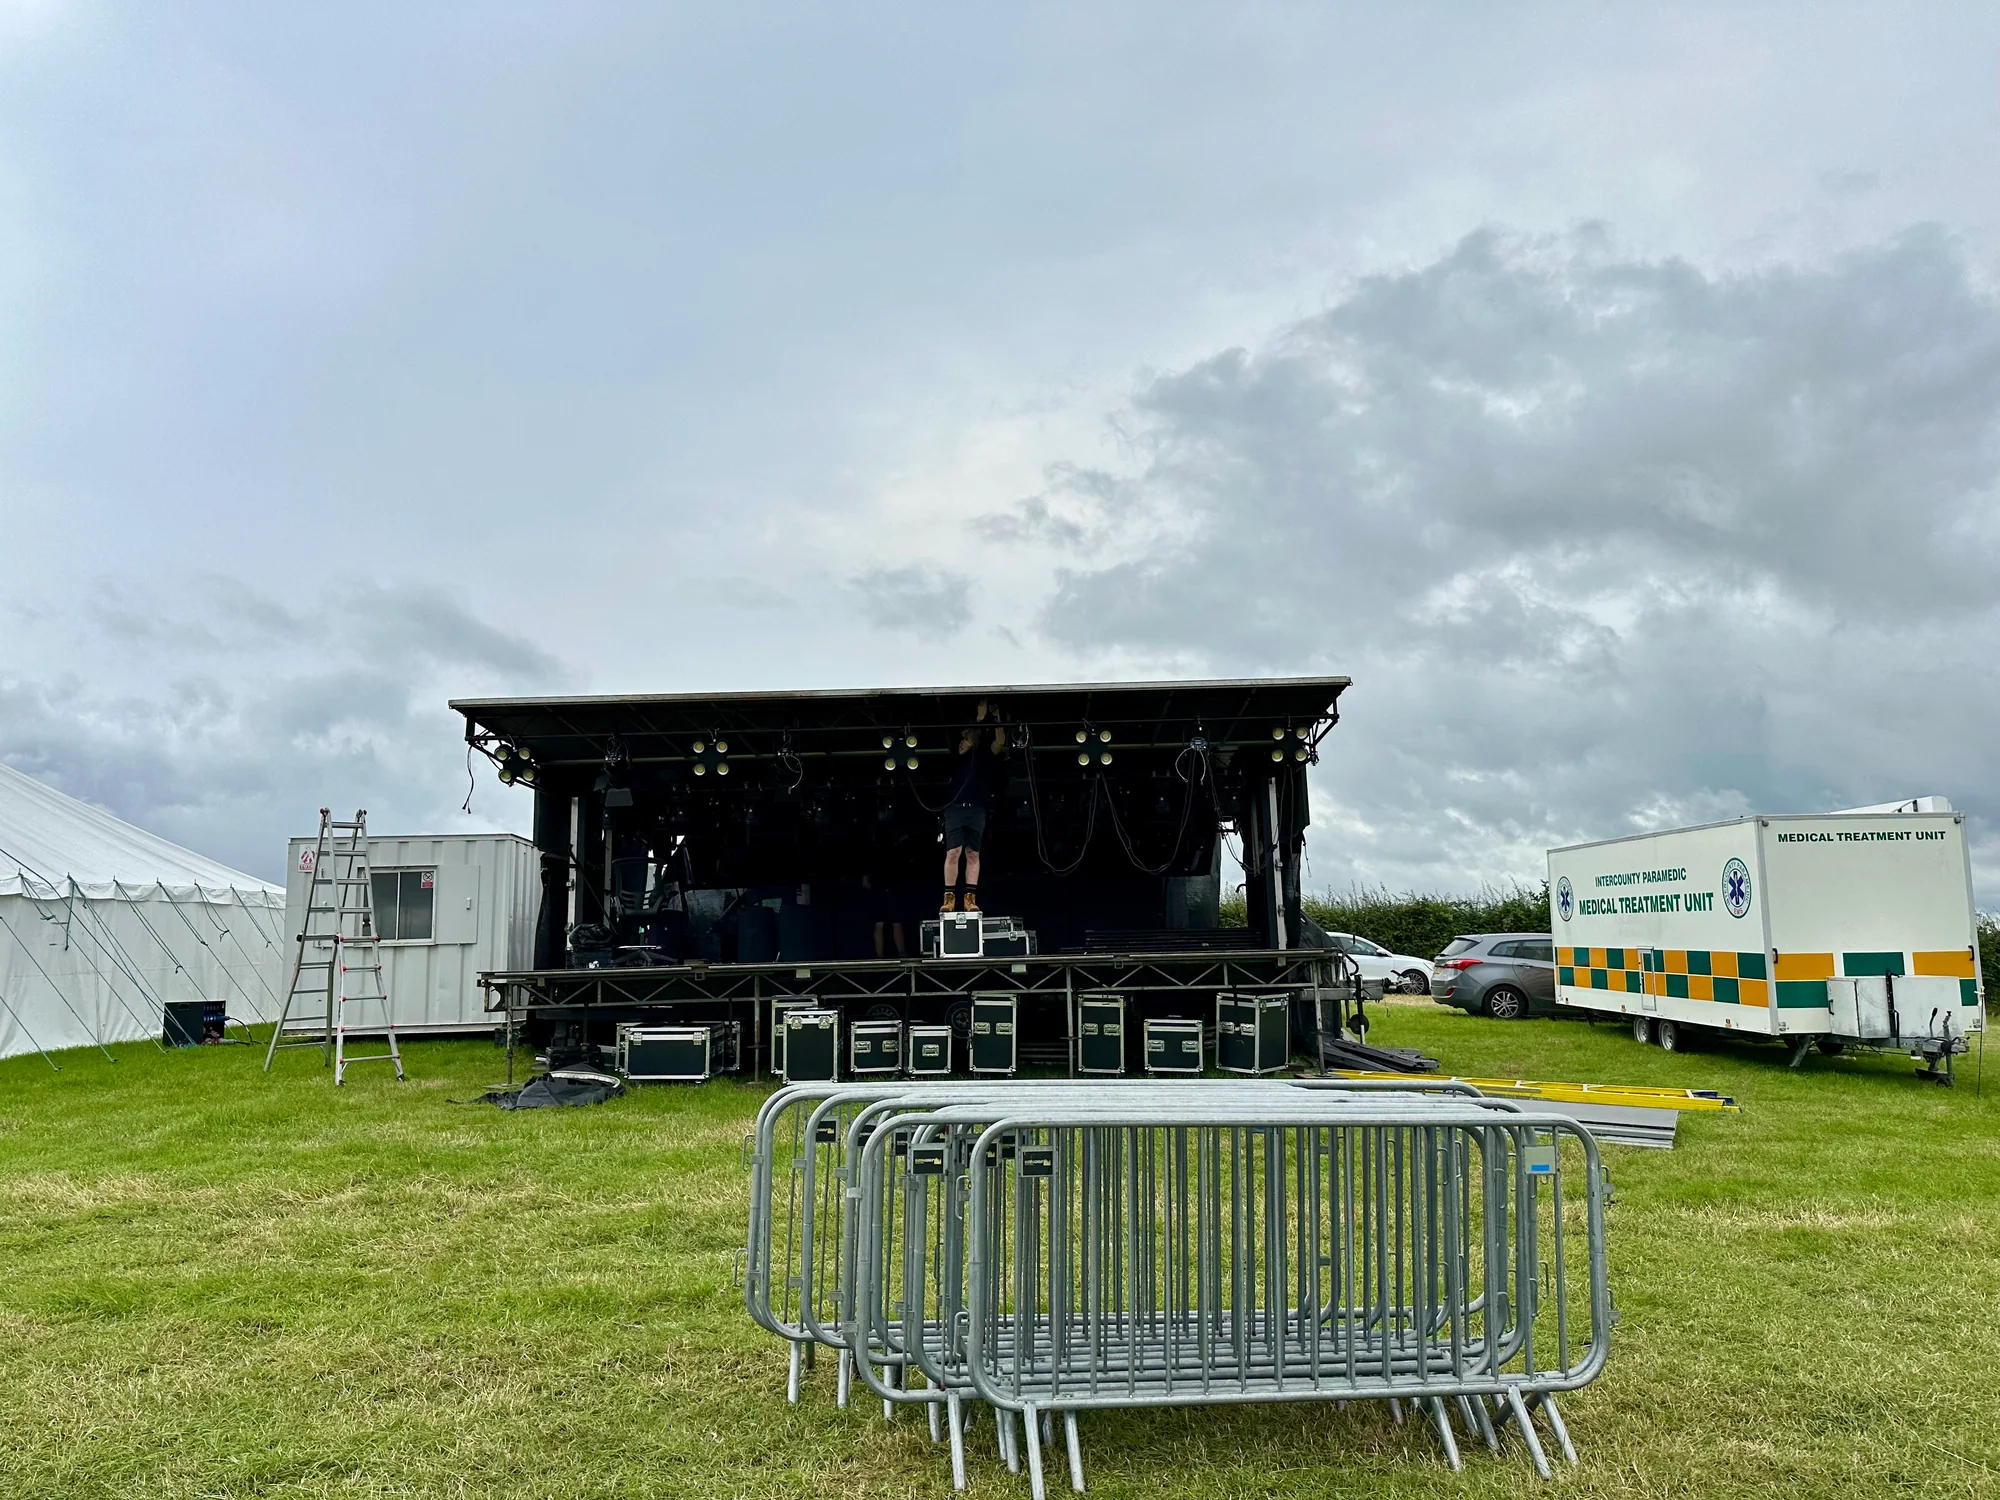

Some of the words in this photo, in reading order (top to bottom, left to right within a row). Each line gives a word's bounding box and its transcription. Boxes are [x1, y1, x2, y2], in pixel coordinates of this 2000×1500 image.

[1778, 833, 1834, 842] MEDICAL
[1836, 832, 1911, 841] TREATMENT
[1915, 831, 1946, 840] UNIT
[1595, 874, 1641, 887] INTERCOUNTY
[1642, 867, 1687, 883] PARAMEDIC
[1579, 899, 1618, 916] MEDICAL
[1618, 894, 1681, 914] TREATMENT
[1684, 892, 1714, 912] UNIT
